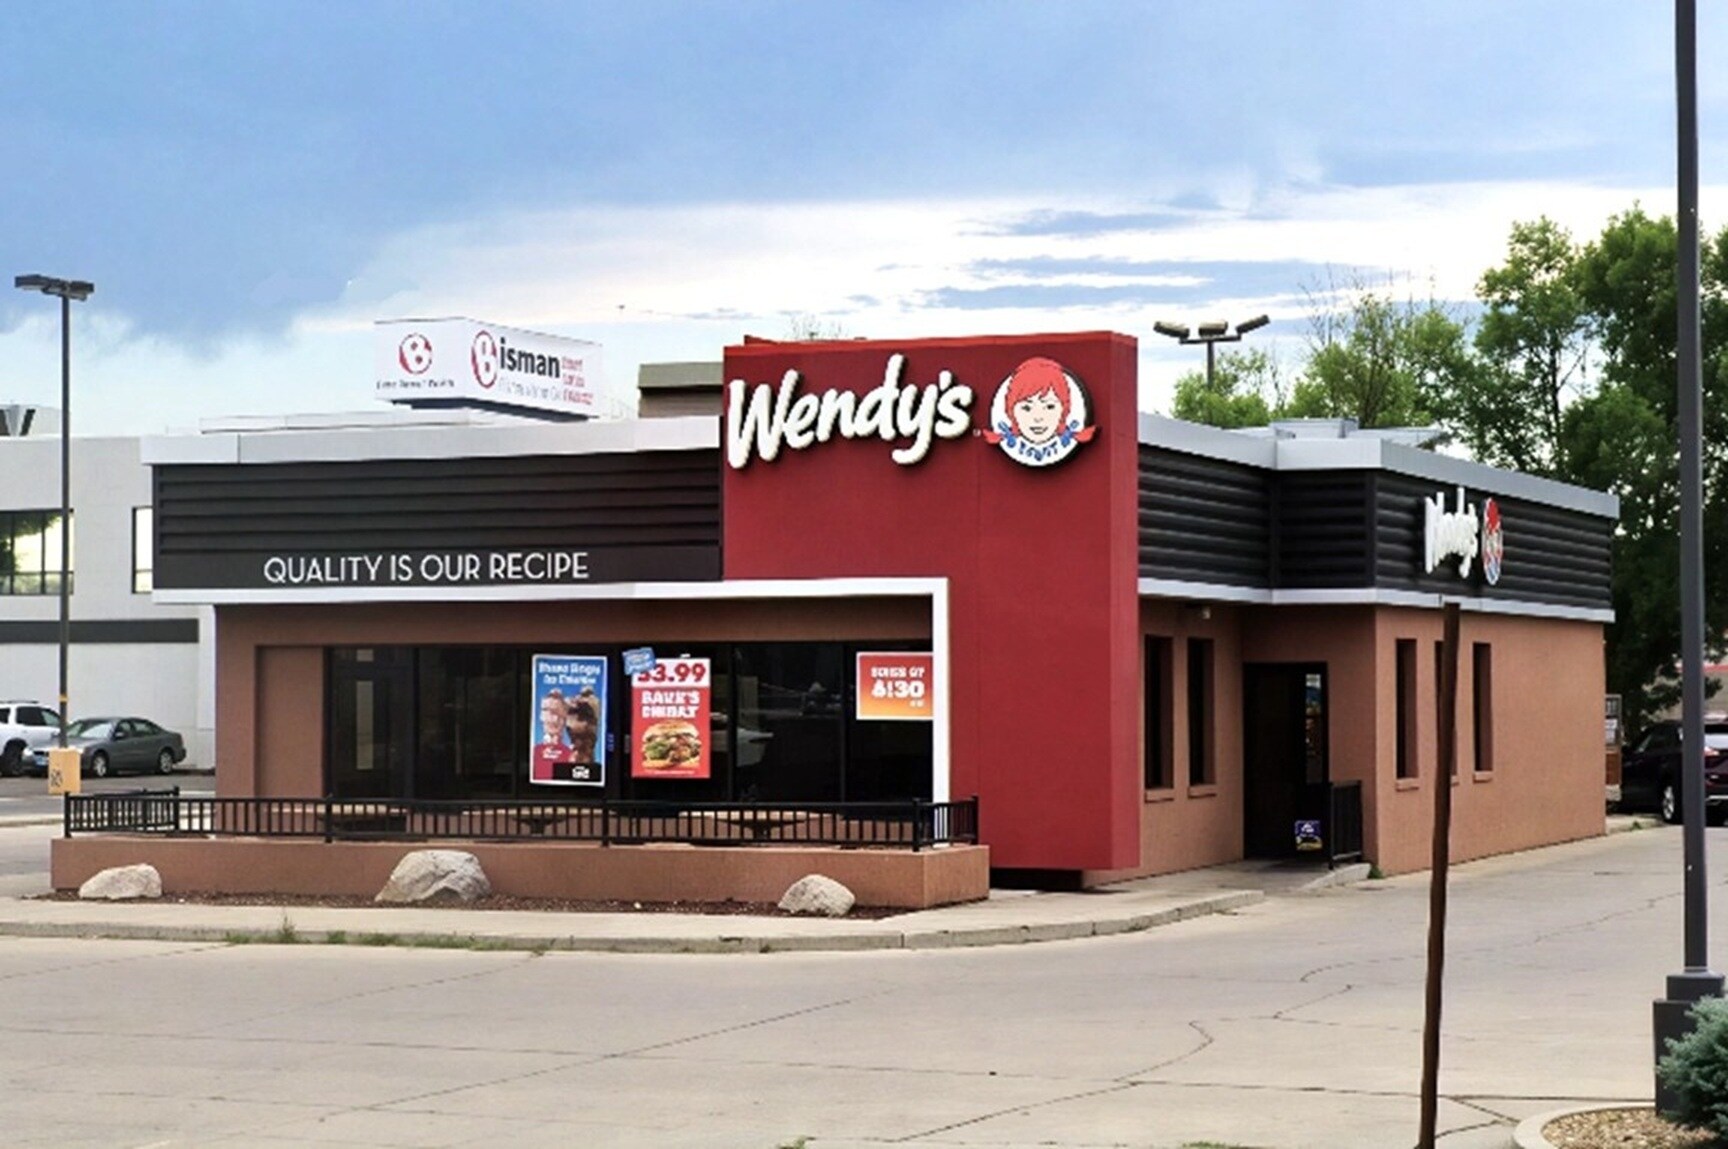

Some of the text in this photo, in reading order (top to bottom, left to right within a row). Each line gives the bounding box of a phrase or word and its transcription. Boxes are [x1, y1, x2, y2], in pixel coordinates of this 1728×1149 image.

[728, 353, 974, 469] Wendy's
[263, 552, 589, 584] QUALITY IS OUR RECIPE
